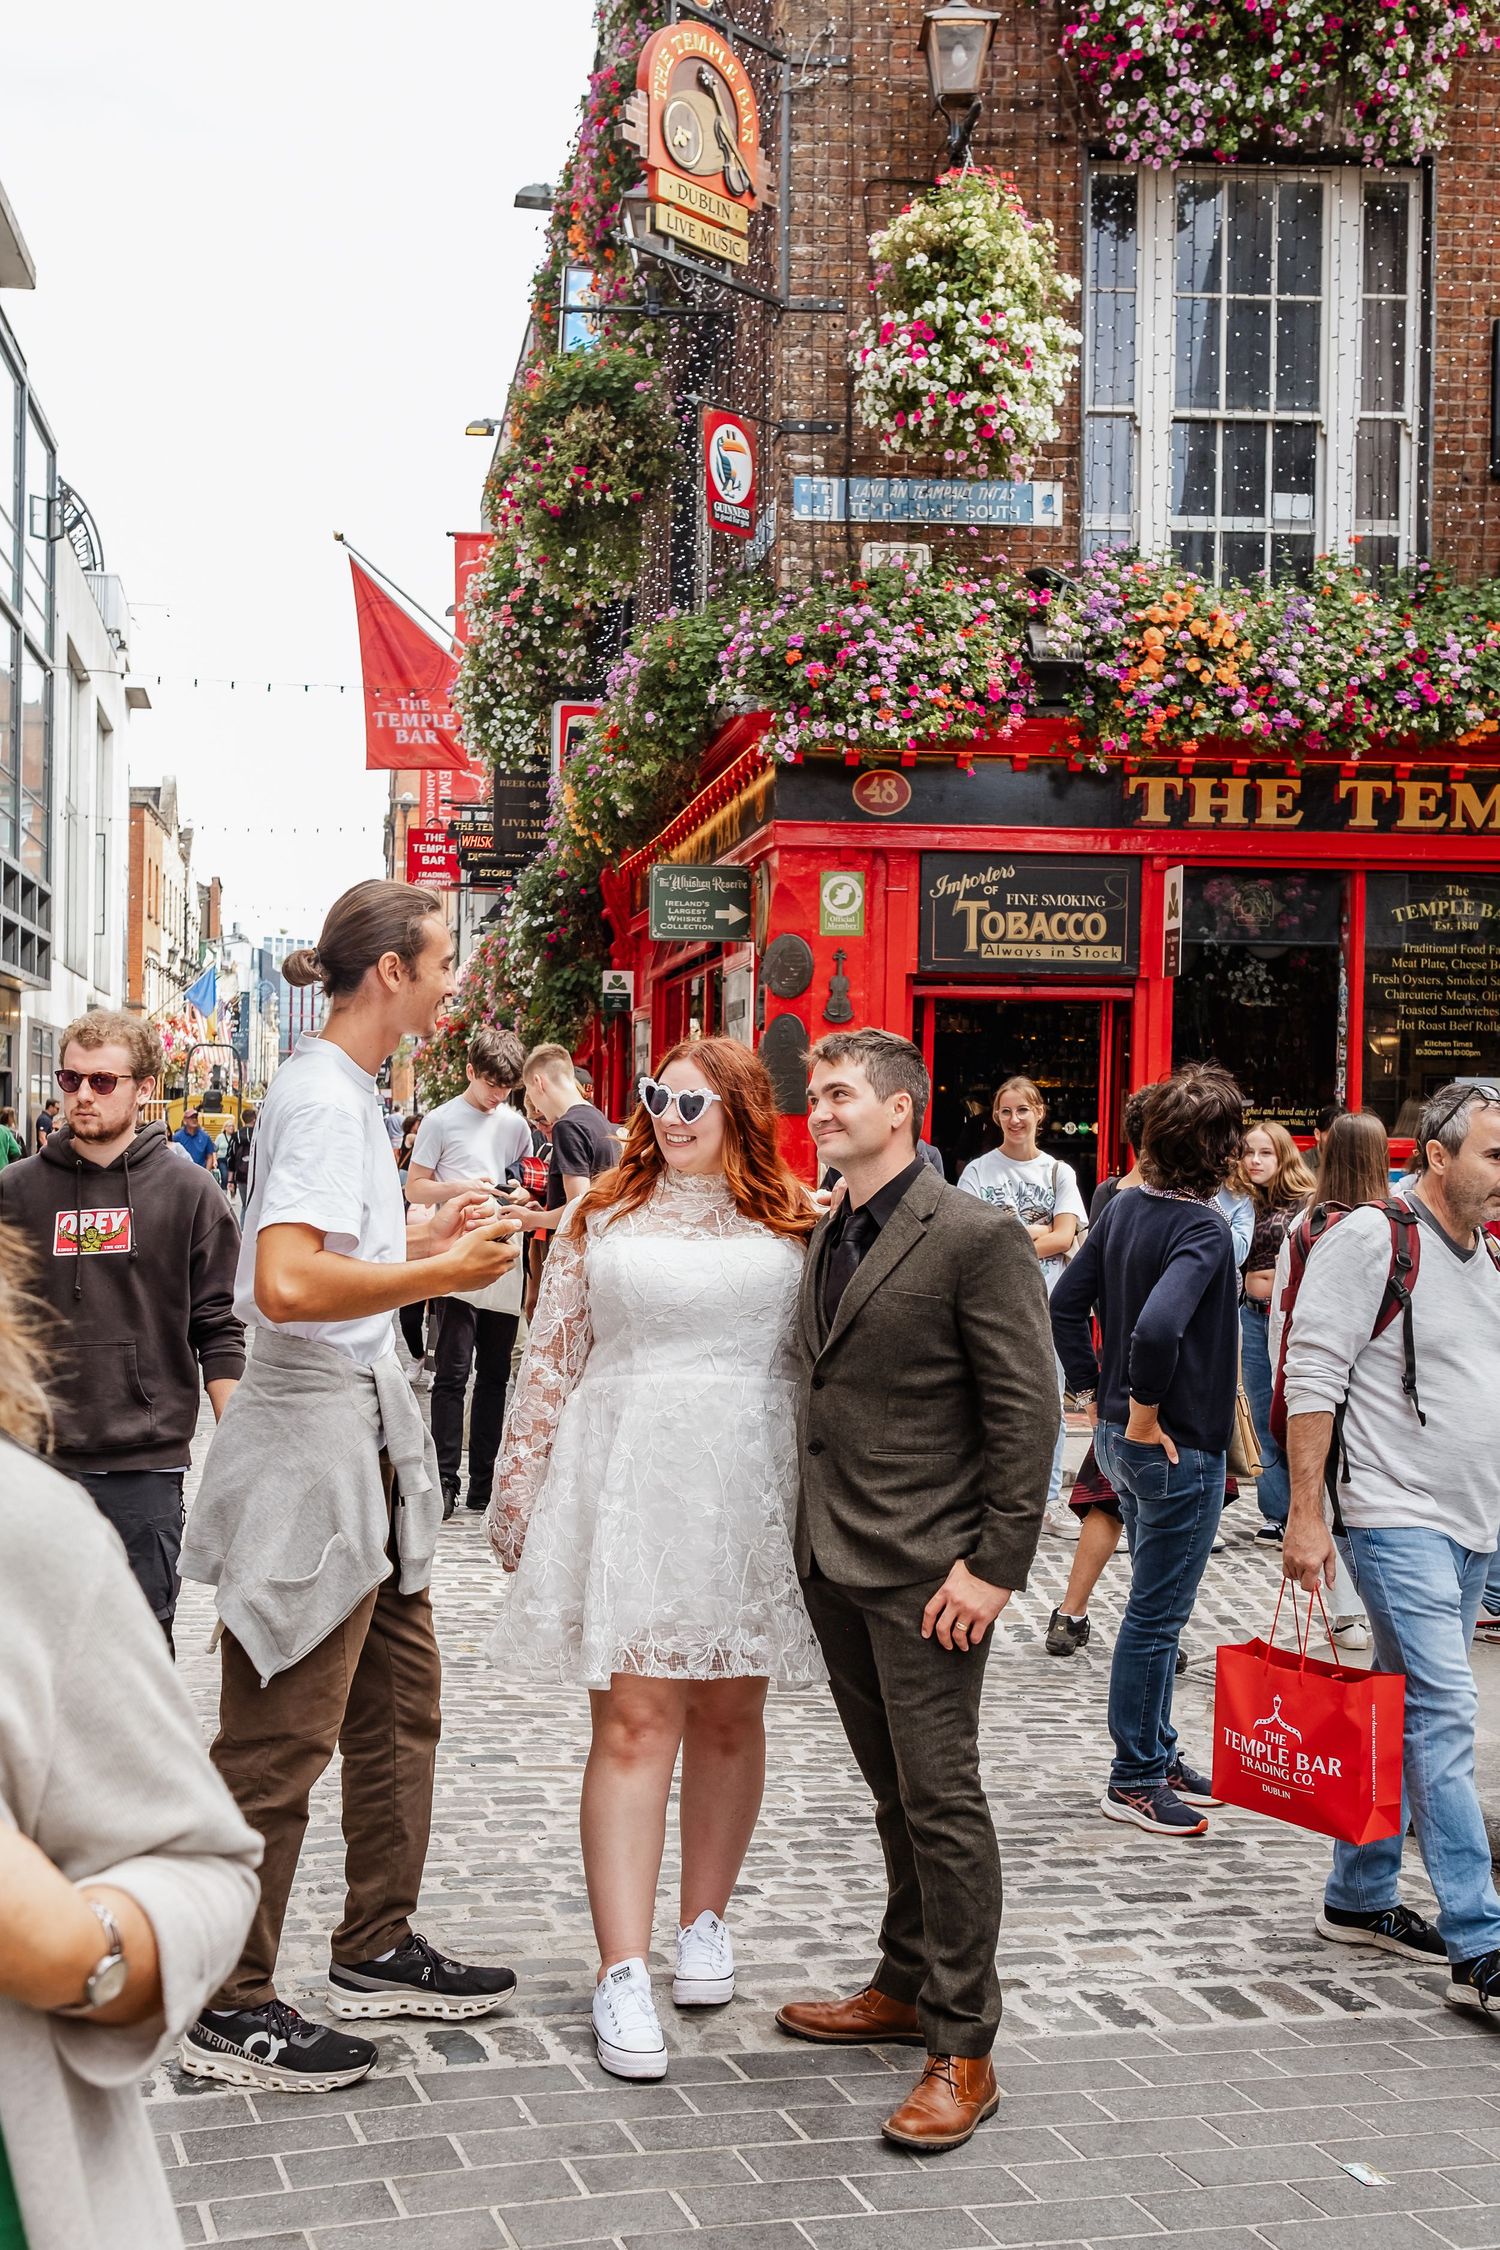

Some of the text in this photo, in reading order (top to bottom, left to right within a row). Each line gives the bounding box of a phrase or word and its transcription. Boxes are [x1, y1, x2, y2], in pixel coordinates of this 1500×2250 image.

[654, 32, 754, 144] THE TEMPLE BAR
[677, 183, 731, 220] DUBLIN
[667, 212, 741, 258] LIVE MUSIC
[889, 484, 908, 498] AN
[714, 501, 750, 520] GUINNESS
[1041, 494, 1054, 514] 2
[965, 504, 1021, 519] SOUTH
[397, 698, 430, 711] THE
[373, 712, 456, 729] TEMPLE
[396, 730, 439, 744] BAR
[426, 770, 436, 807] ADING
[500, 779, 549, 789] BEER GAR
[863, 776, 898, 804] 48
[438, 769, 452, 826] EMPLE
[1127, 777, 1500, 830] THE TEM
[454, 821, 474, 831] THE
[502, 818, 528, 828] LIVE
[424, 832, 445, 842] THE
[412, 843, 457, 854] TEMPLE
[421, 855, 445, 865] BAR
[418, 871, 451, 879] TRADING
[479, 868, 512, 877] STORE
[657, 874, 748, 893] The Whiskey Reserve
[929, 864, 1016, 899] Importers
[983, 885, 999, 895] OF
[1446, 884, 1469, 896] The
[1006, 893, 1107, 907] FINE SMOKING
[668, 907, 706, 915] LARGEST
[1391, 900, 1475, 922] TEMPLE
[952, 900, 1108, 953] TOBACCO
[1435, 921, 1479, 930] Est. 1840
[984, 944, 1119, 959] Always in Stock
[1403, 943, 1457, 954] Traditional
[1460, 944, 1486, 955] Food
[1391, 958, 1417, 968] Meat
[1421, 958, 1448, 970] Plate,
[1451, 959, 1487, 970] Cheese
[1372, 973, 1400, 984] Fresh
[1402, 974, 1444, 987] Oysters,
[1447, 975, 1487, 986] Smoked
[1384, 989, 1443, 1000] Charcuterie
[1445, 990, 1479, 1001] Meats,
[1398, 1004, 1500, 1016] Toasted Sandwiches
[1396, 1020, 1415, 1030] Hot
[1418, 1020, 1446, 1030] Roast
[1449, 1021, 1474, 1031] Beef
[1424, 1040, 1473, 1048] Kitchen Times
[1264, 1730, 1287, 1746] THE
[1224, 1726, 1342, 1777] TEMPLE BAR
[1240, 1754, 1315, 1787] TRADING CO.
[1262, 1783, 1291, 1800] DUBLIN
